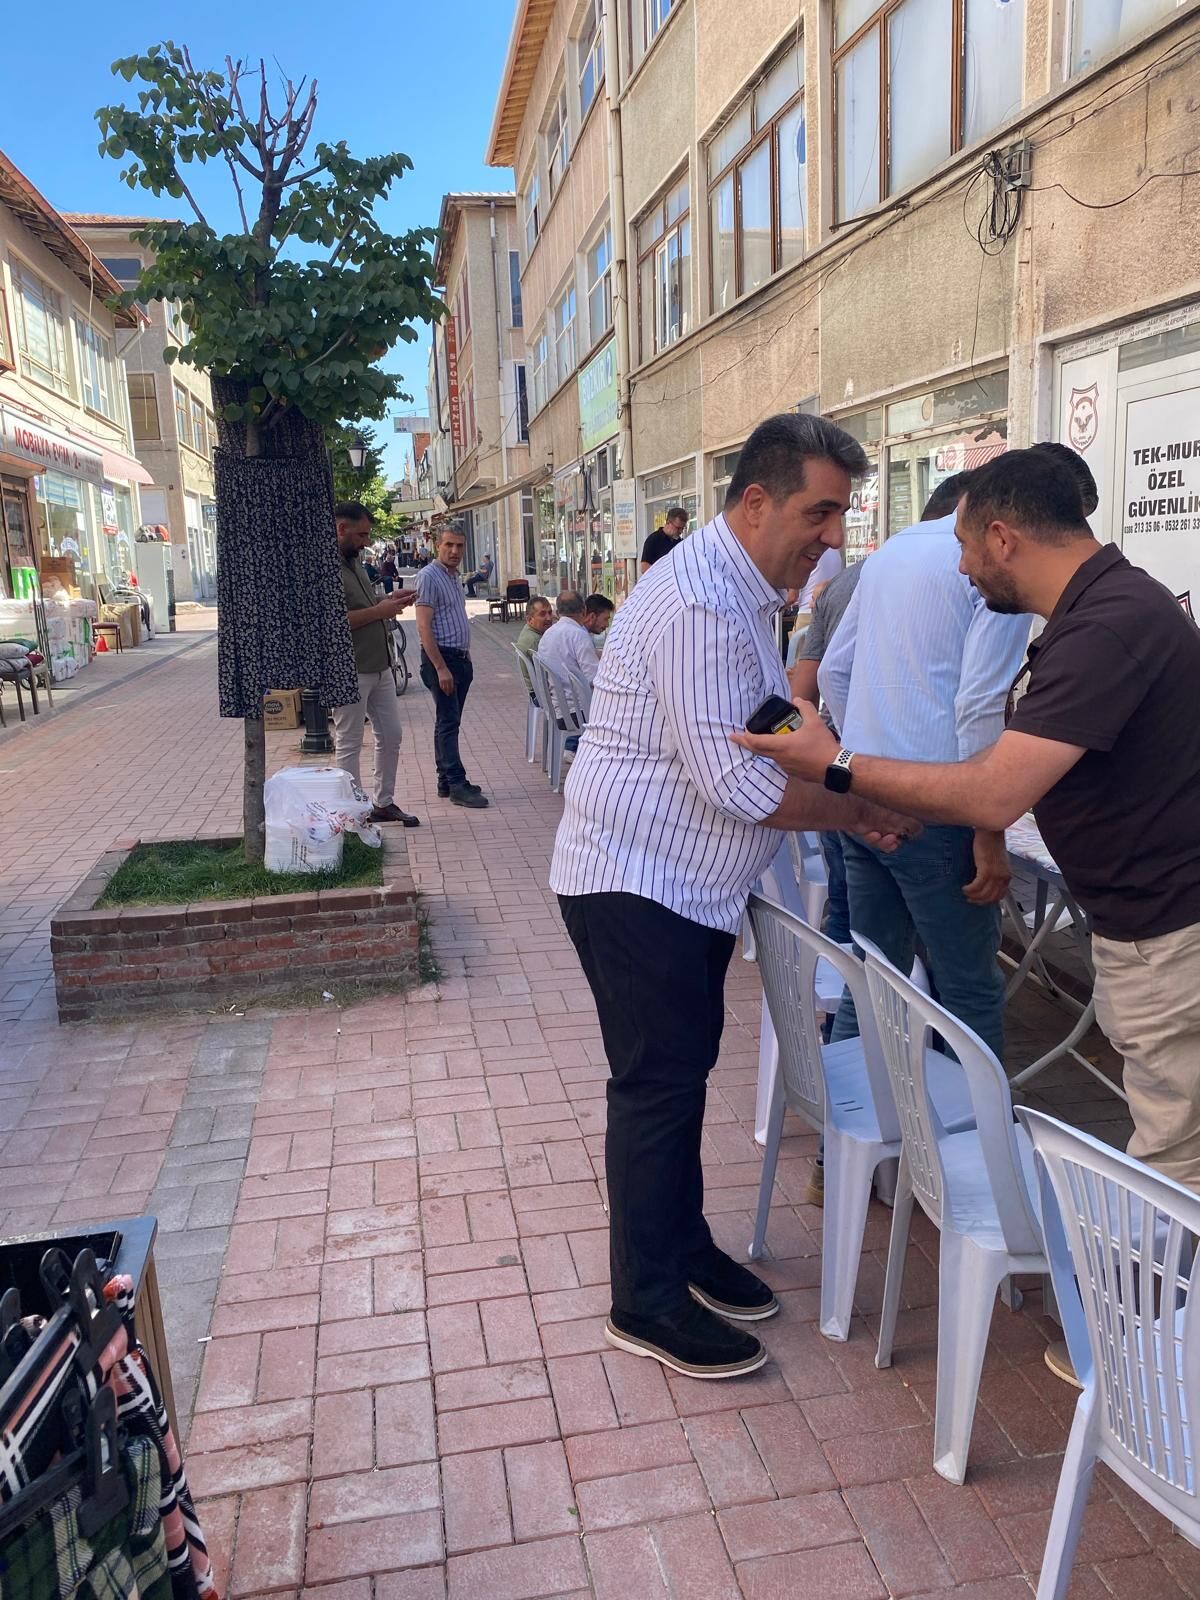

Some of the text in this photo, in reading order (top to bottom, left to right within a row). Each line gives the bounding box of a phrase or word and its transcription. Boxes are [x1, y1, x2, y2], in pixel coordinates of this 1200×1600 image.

[449, 353, 458, 386] SPOR
[451, 396, 461, 446] CENTER
[1147, 468, 1185, 491] ÖZEL
[1134, 521, 1144, 533] 213
[1145, 521, 1152, 533] 35
[1165, 519, 1179, 531] 0532
[1180, 518, 1191, 530] 261
